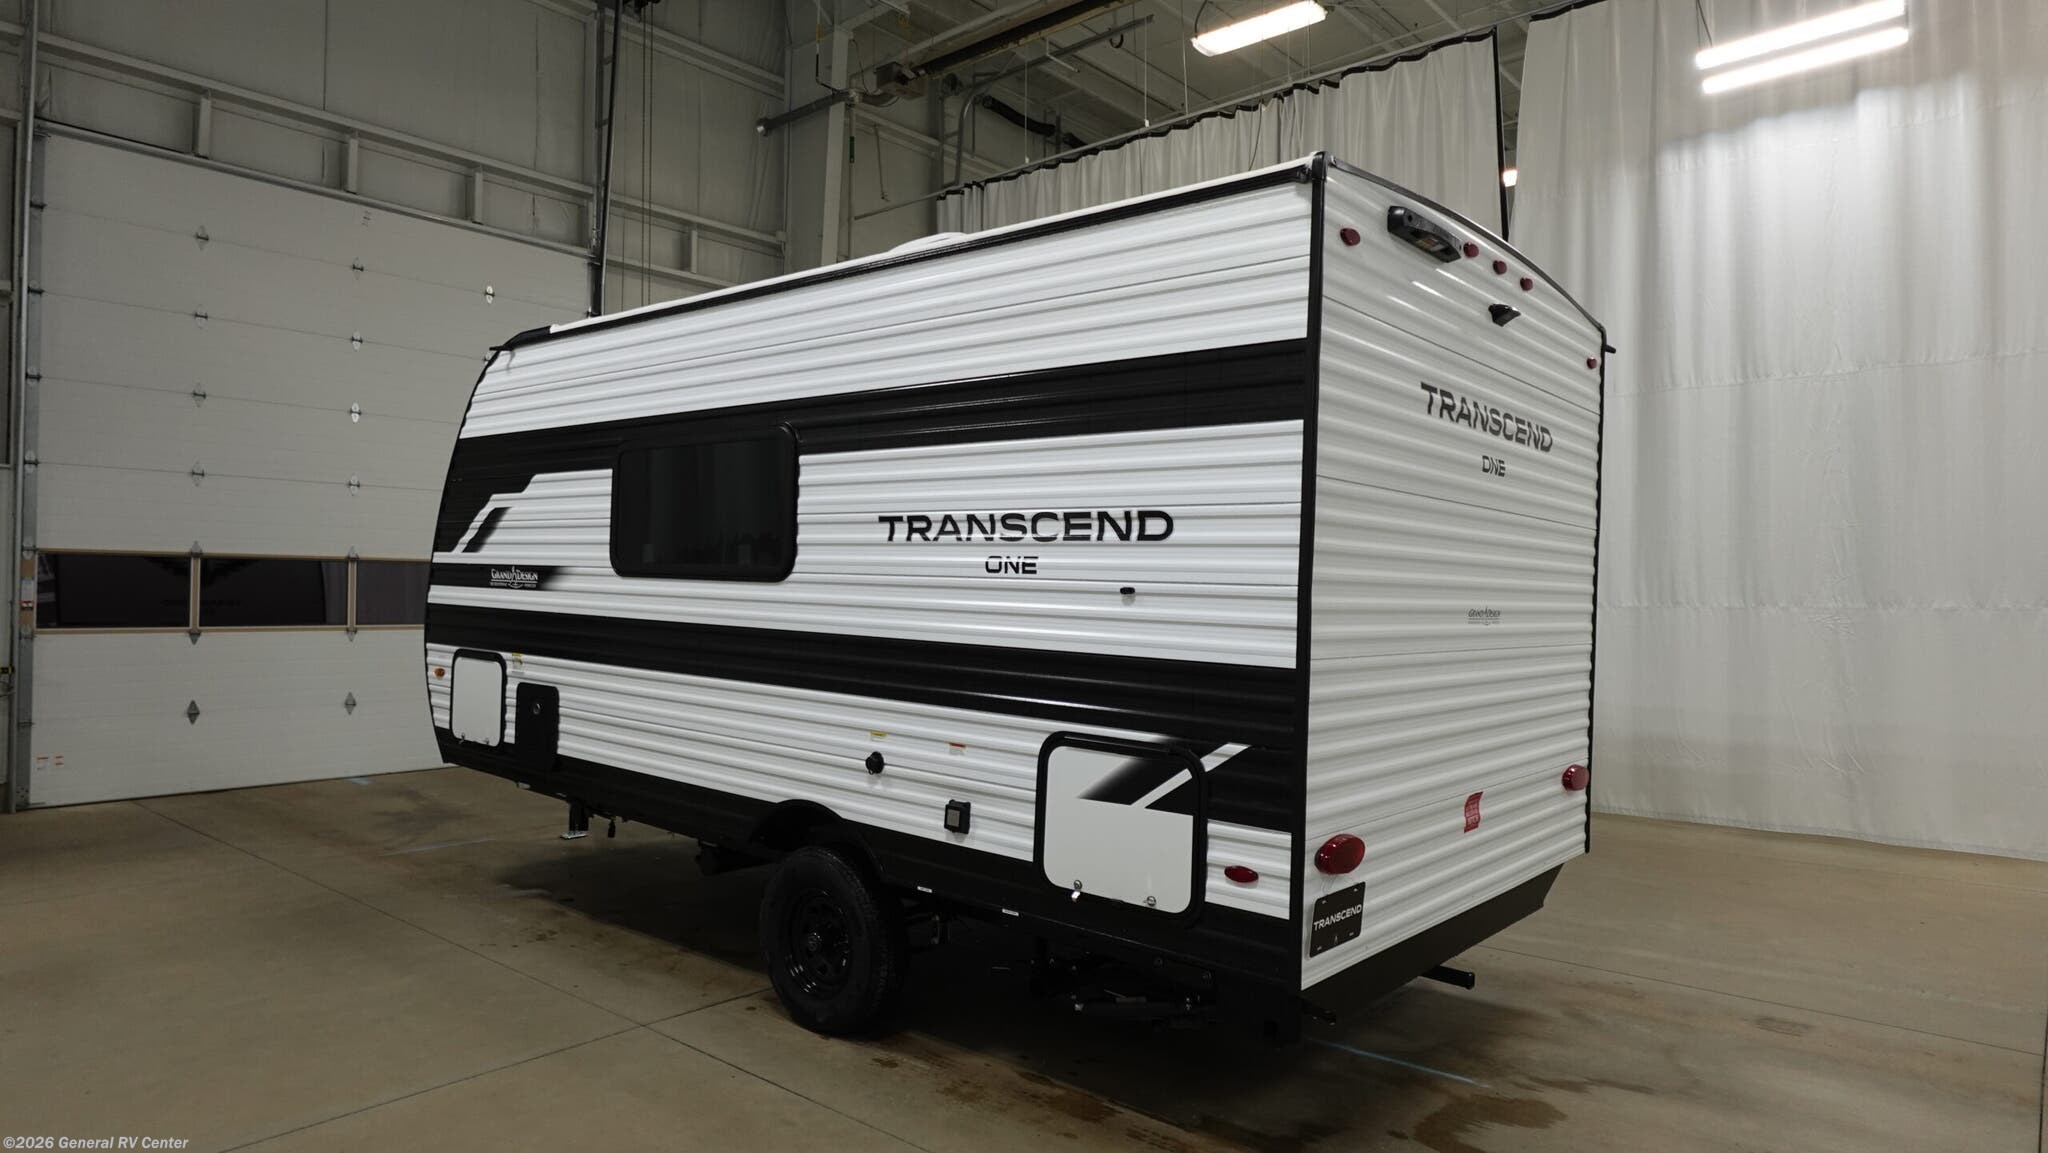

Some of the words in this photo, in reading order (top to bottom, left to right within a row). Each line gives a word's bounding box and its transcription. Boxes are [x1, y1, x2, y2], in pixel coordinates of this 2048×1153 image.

[1420, 381, 1553, 452] TRANSCEND
[878, 510, 1175, 542] TRANSCEND
[984, 555, 1039, 575] ONE
[1313, 904, 1362, 931] TRANSCEND
